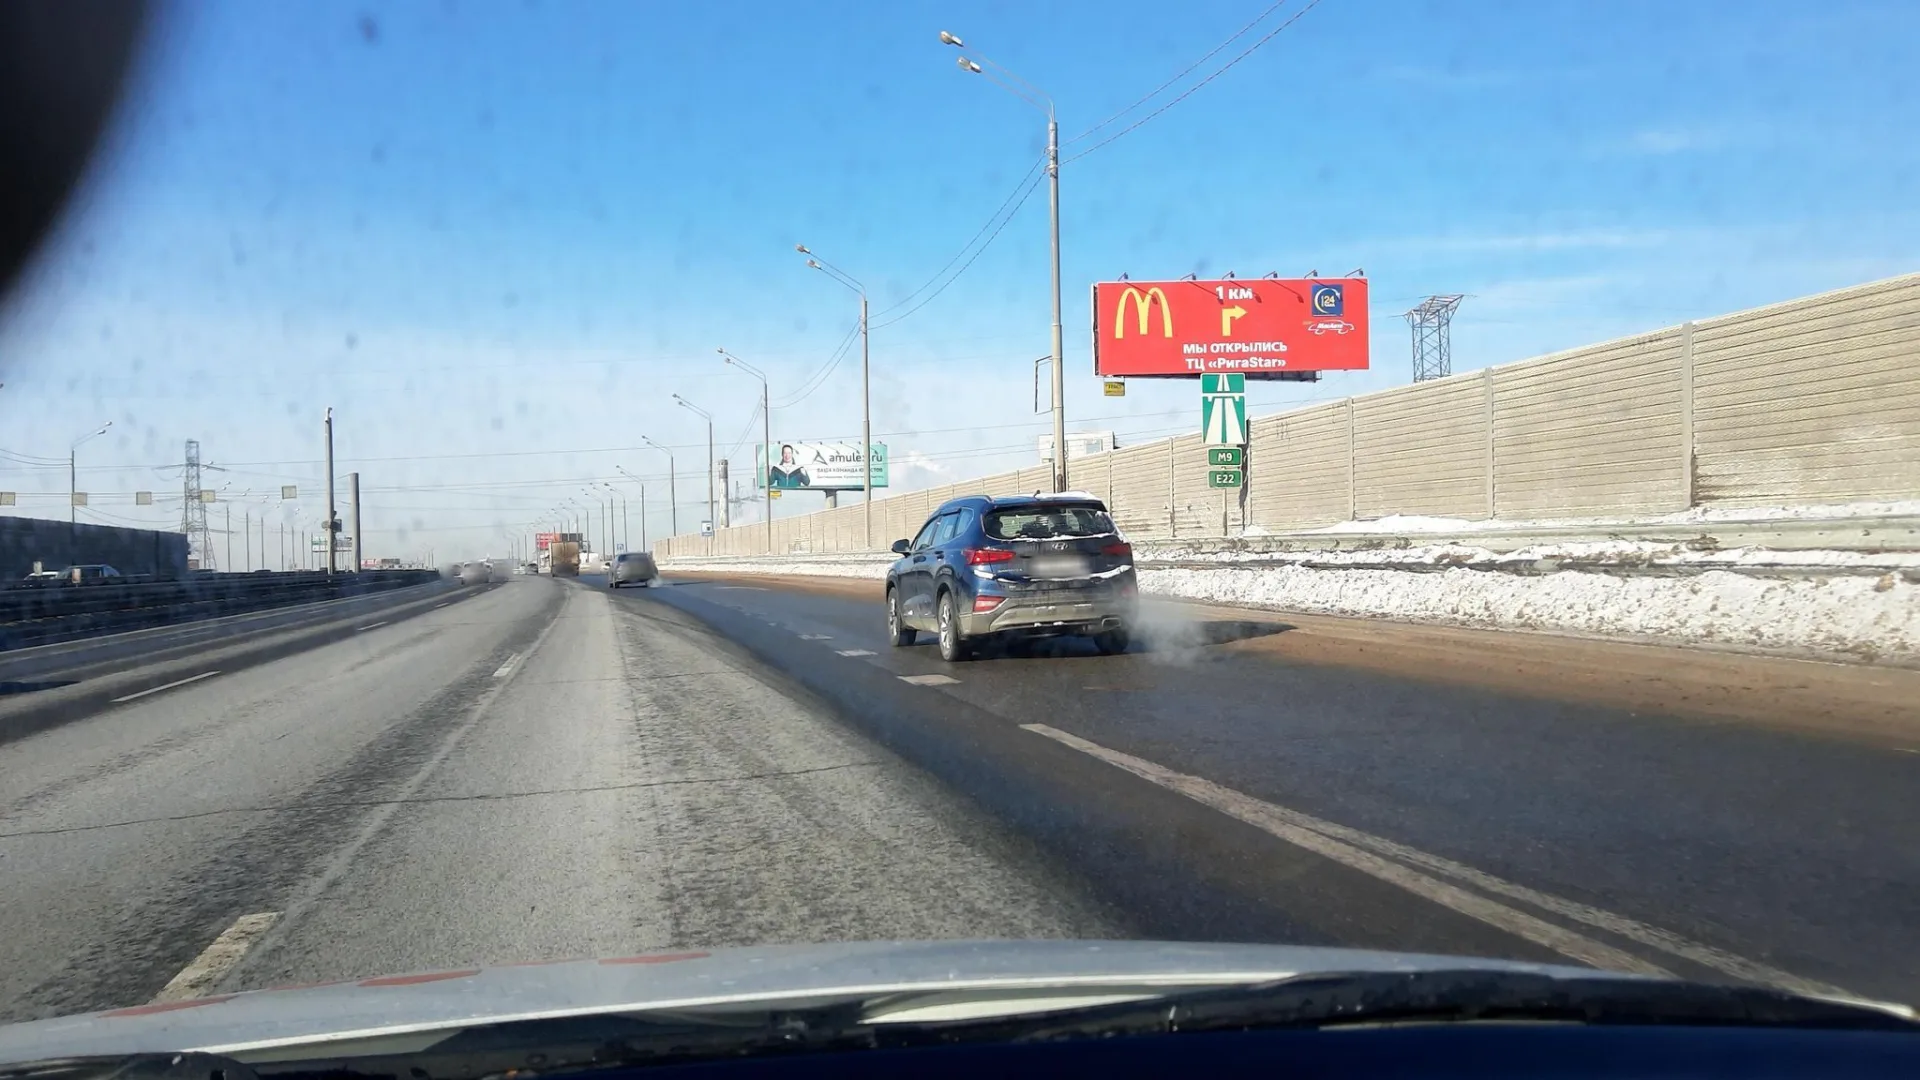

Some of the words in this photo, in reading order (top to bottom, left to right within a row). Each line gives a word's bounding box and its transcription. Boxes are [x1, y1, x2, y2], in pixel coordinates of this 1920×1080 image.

[1216, 286, 1224, 299] 1
[1323, 295, 1336, 304] 24
[1185, 358, 1206, 371] ТЦ
[829, 452, 883, 463] amuleru
[1218, 453, 1233, 462] M9
[1216, 475, 1235, 484] E22
